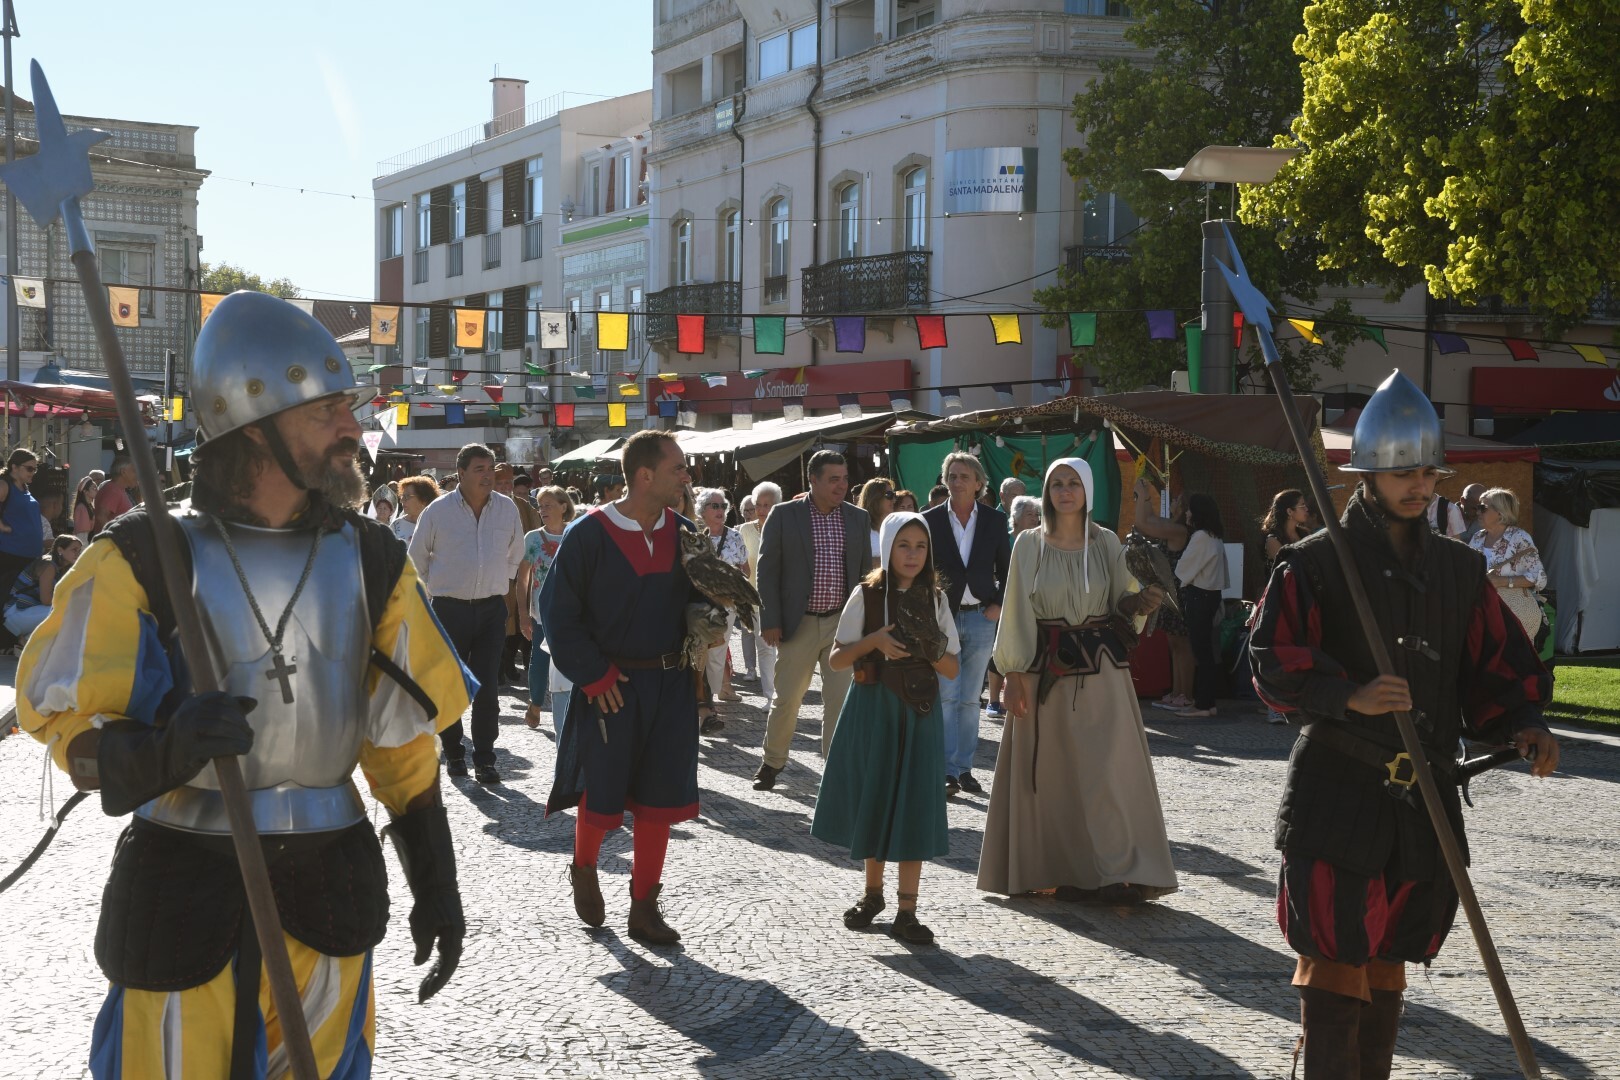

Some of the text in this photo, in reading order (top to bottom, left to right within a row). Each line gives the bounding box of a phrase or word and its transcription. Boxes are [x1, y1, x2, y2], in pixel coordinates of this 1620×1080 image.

[949, 185, 1025, 197] SANTA MADALENA
[766, 381, 809, 398] Santander
